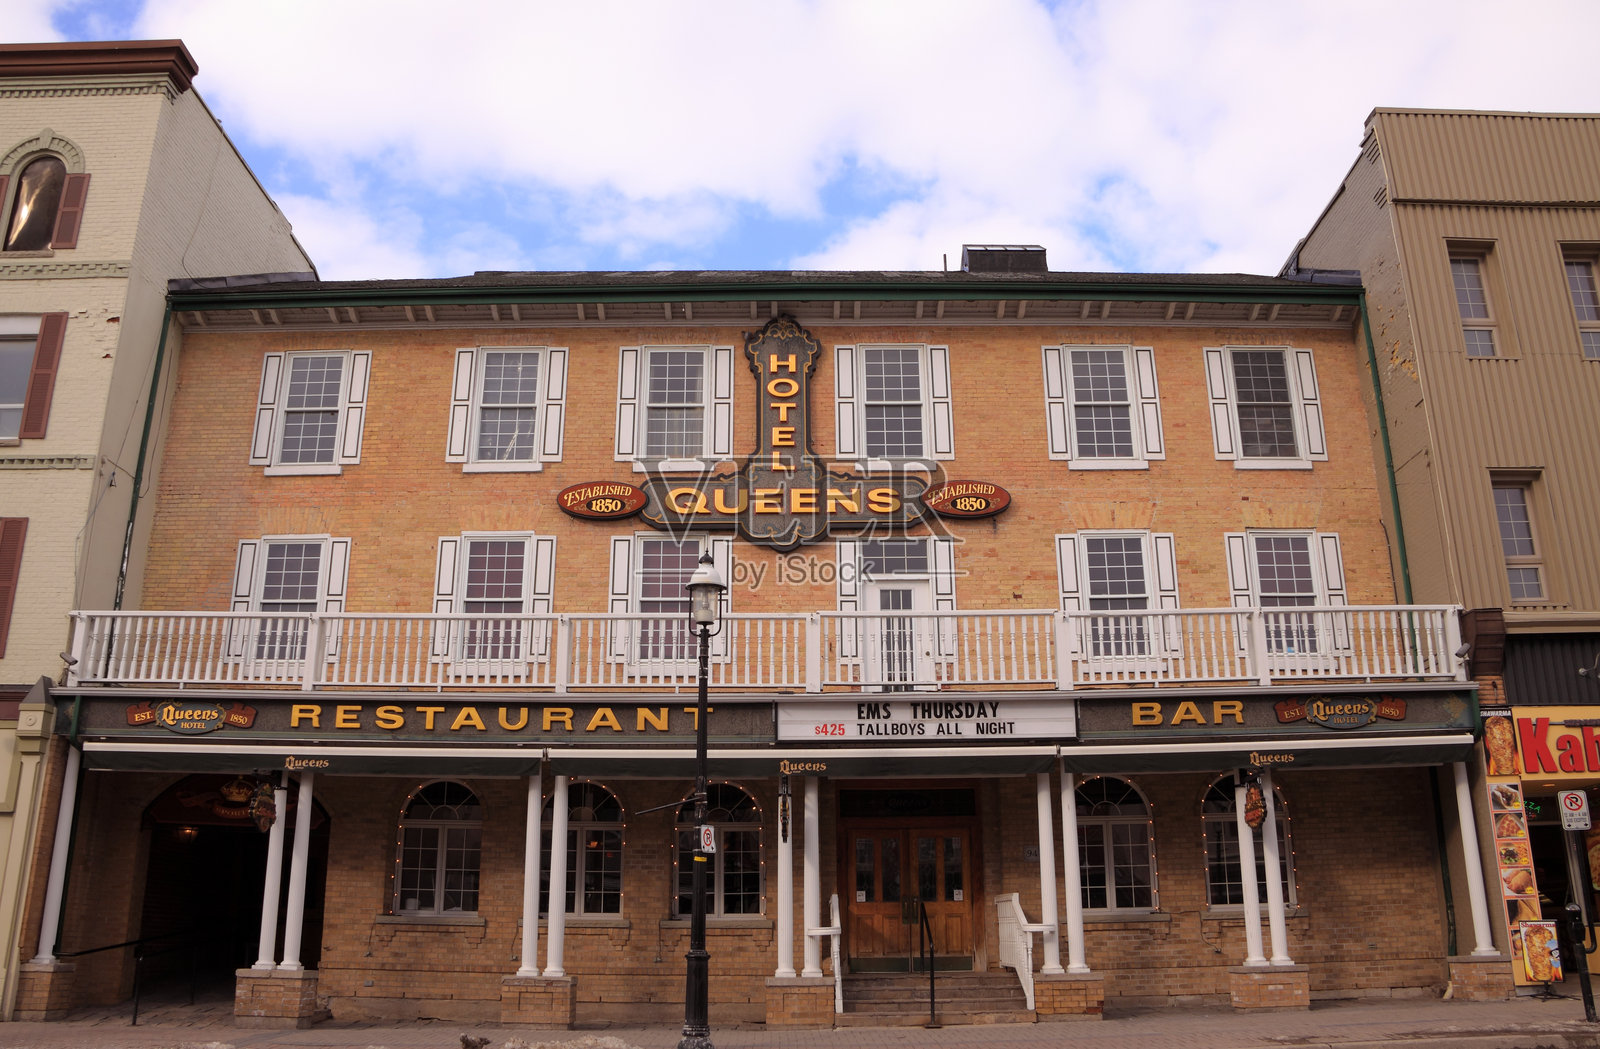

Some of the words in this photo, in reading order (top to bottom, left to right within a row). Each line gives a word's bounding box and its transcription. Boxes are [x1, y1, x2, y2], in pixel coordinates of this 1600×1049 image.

[767, 354, 799, 471] HOTEL
[564, 485, 632, 506] ESTABLISHED
[664, 487, 901, 515] QUEENS
[928, 483, 995, 506] ESTABLISHED
[590, 500, 622, 513] 1850
[955, 497, 986, 512] 1850
[134, 711, 153, 722] EST.
[162, 705, 219, 726] Queens
[857, 703, 891, 719] EMS
[910, 701, 1000, 719] THURSDAY
[1131, 700, 1245, 726] BAR
[1284, 708, 1303, 719] EST.
[1312, 700, 1369, 721] Queens
[1381, 706, 1399, 717] 1850
[180, 721, 206, 729] HOTEL
[229, 713, 248, 725] 1850
[290, 704, 713, 732] RESTAURANT
[1333, 716, 1359, 724] HOTEL
[815, 723, 845, 736] $425
[857, 722, 925, 736] TALLBOYS
[936, 722, 962, 735] ALL
[976, 721, 1015, 735] NIGHT
[284, 755, 329, 770] Queens
[1250, 751, 1294, 766] Queens
[780, 759, 827, 775] Queens
